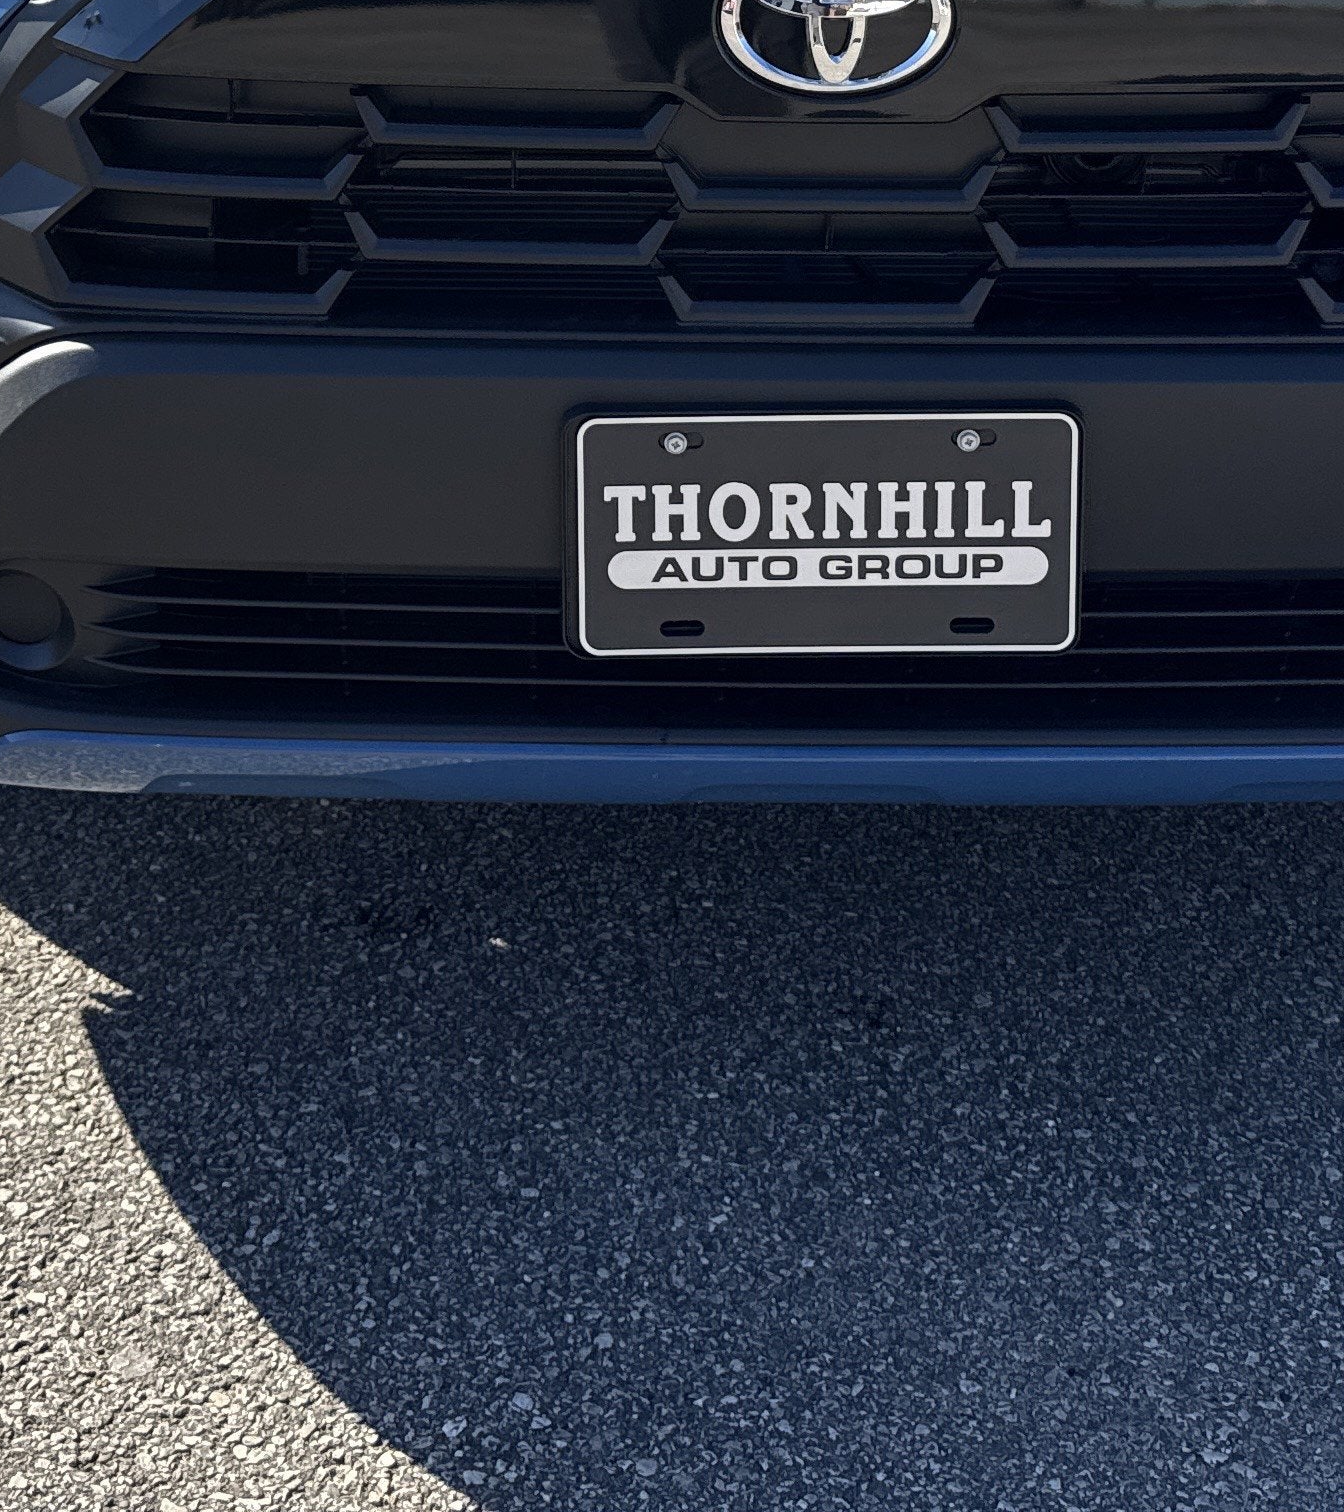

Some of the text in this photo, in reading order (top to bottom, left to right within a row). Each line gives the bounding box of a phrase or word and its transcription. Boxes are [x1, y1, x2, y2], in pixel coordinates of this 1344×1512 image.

[603, 481, 1052, 543] THORNHILL
[651, 553, 1004, 583] AUTO GROUP
